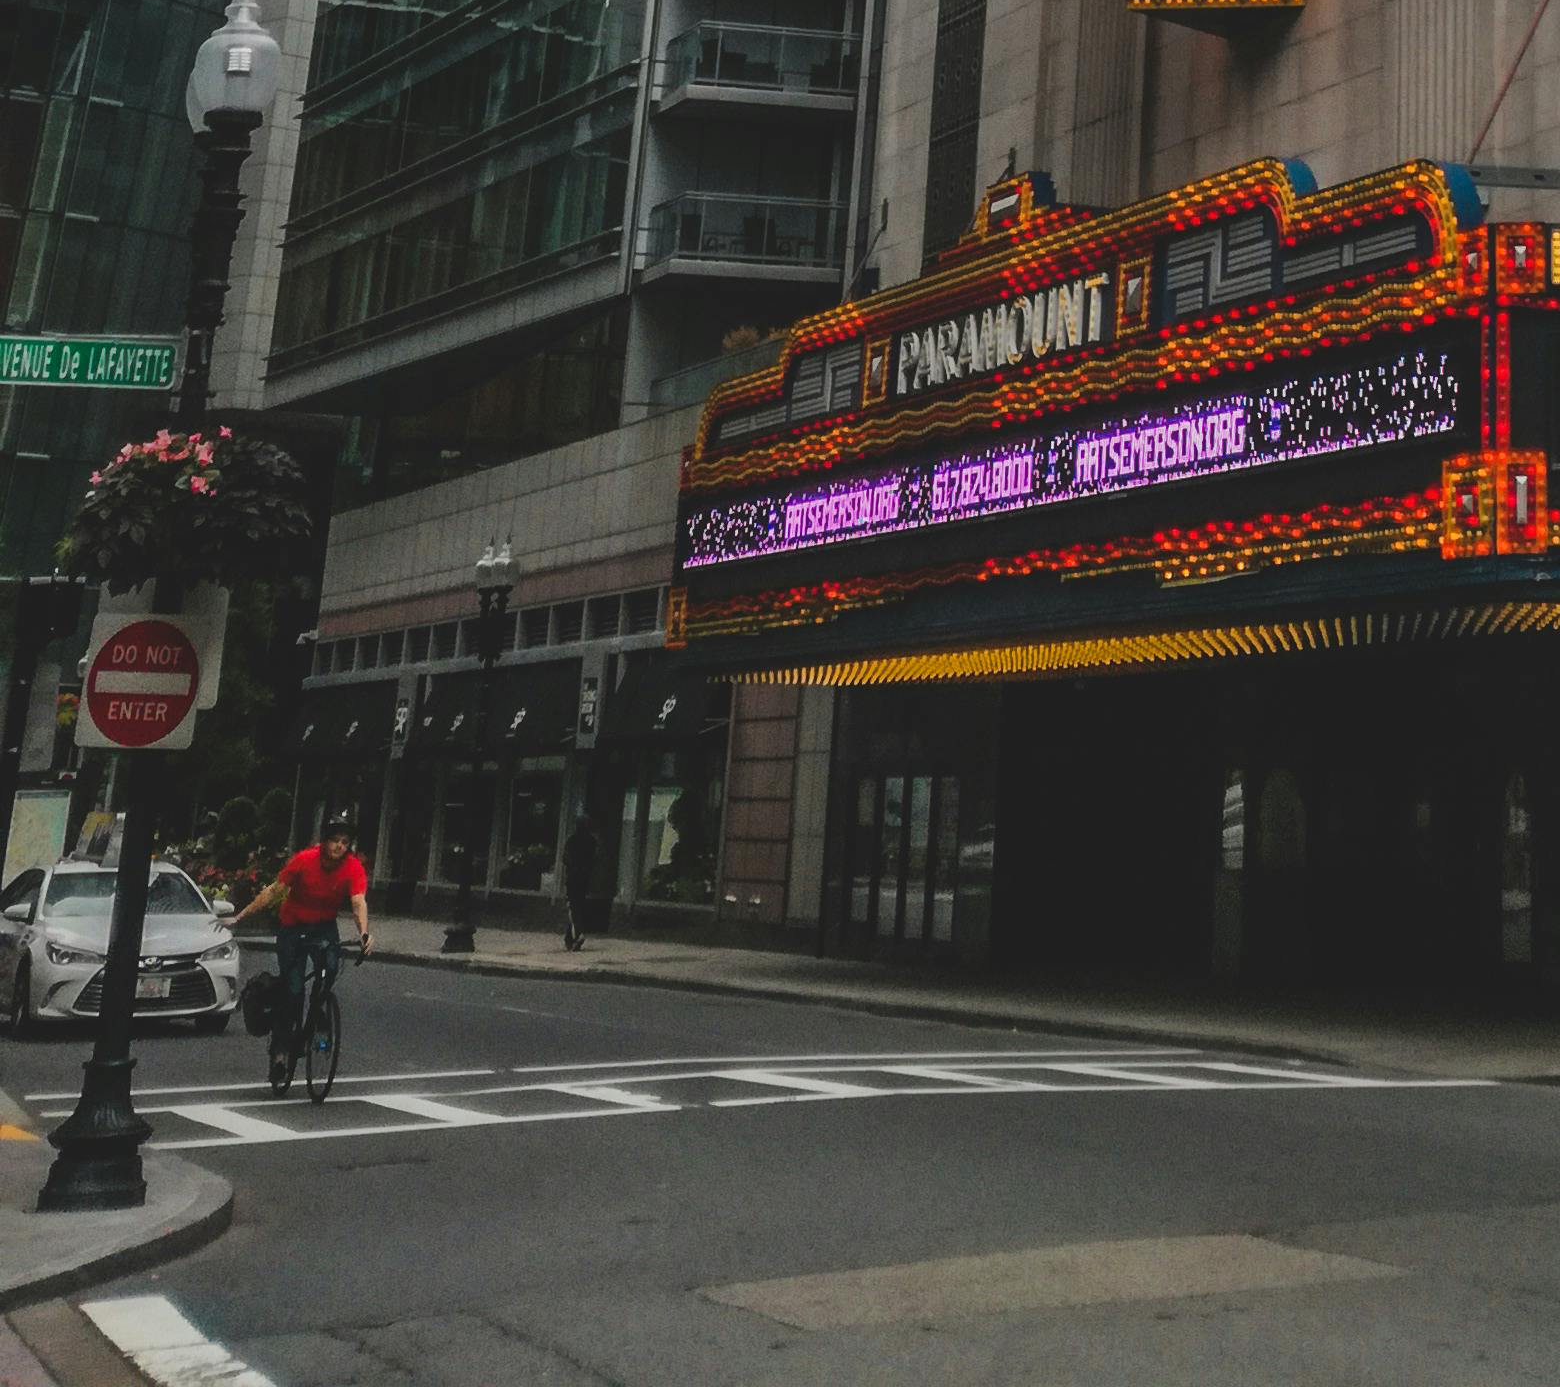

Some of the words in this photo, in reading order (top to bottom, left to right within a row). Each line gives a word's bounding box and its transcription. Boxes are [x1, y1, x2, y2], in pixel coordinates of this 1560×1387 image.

[896, 272, 1110, 394] PARAMOUNT
[0, 343, 54, 379] VENUE
[59, 345, 81, 381] De
[86, 346, 170, 383] LAFAYETTE
[1076, 407, 1246, 483] ARTSEMERSON.ORG
[111, 644, 138, 665] DO
[145, 645, 183, 666] NOT
[107, 700, 169, 723] ENTER
